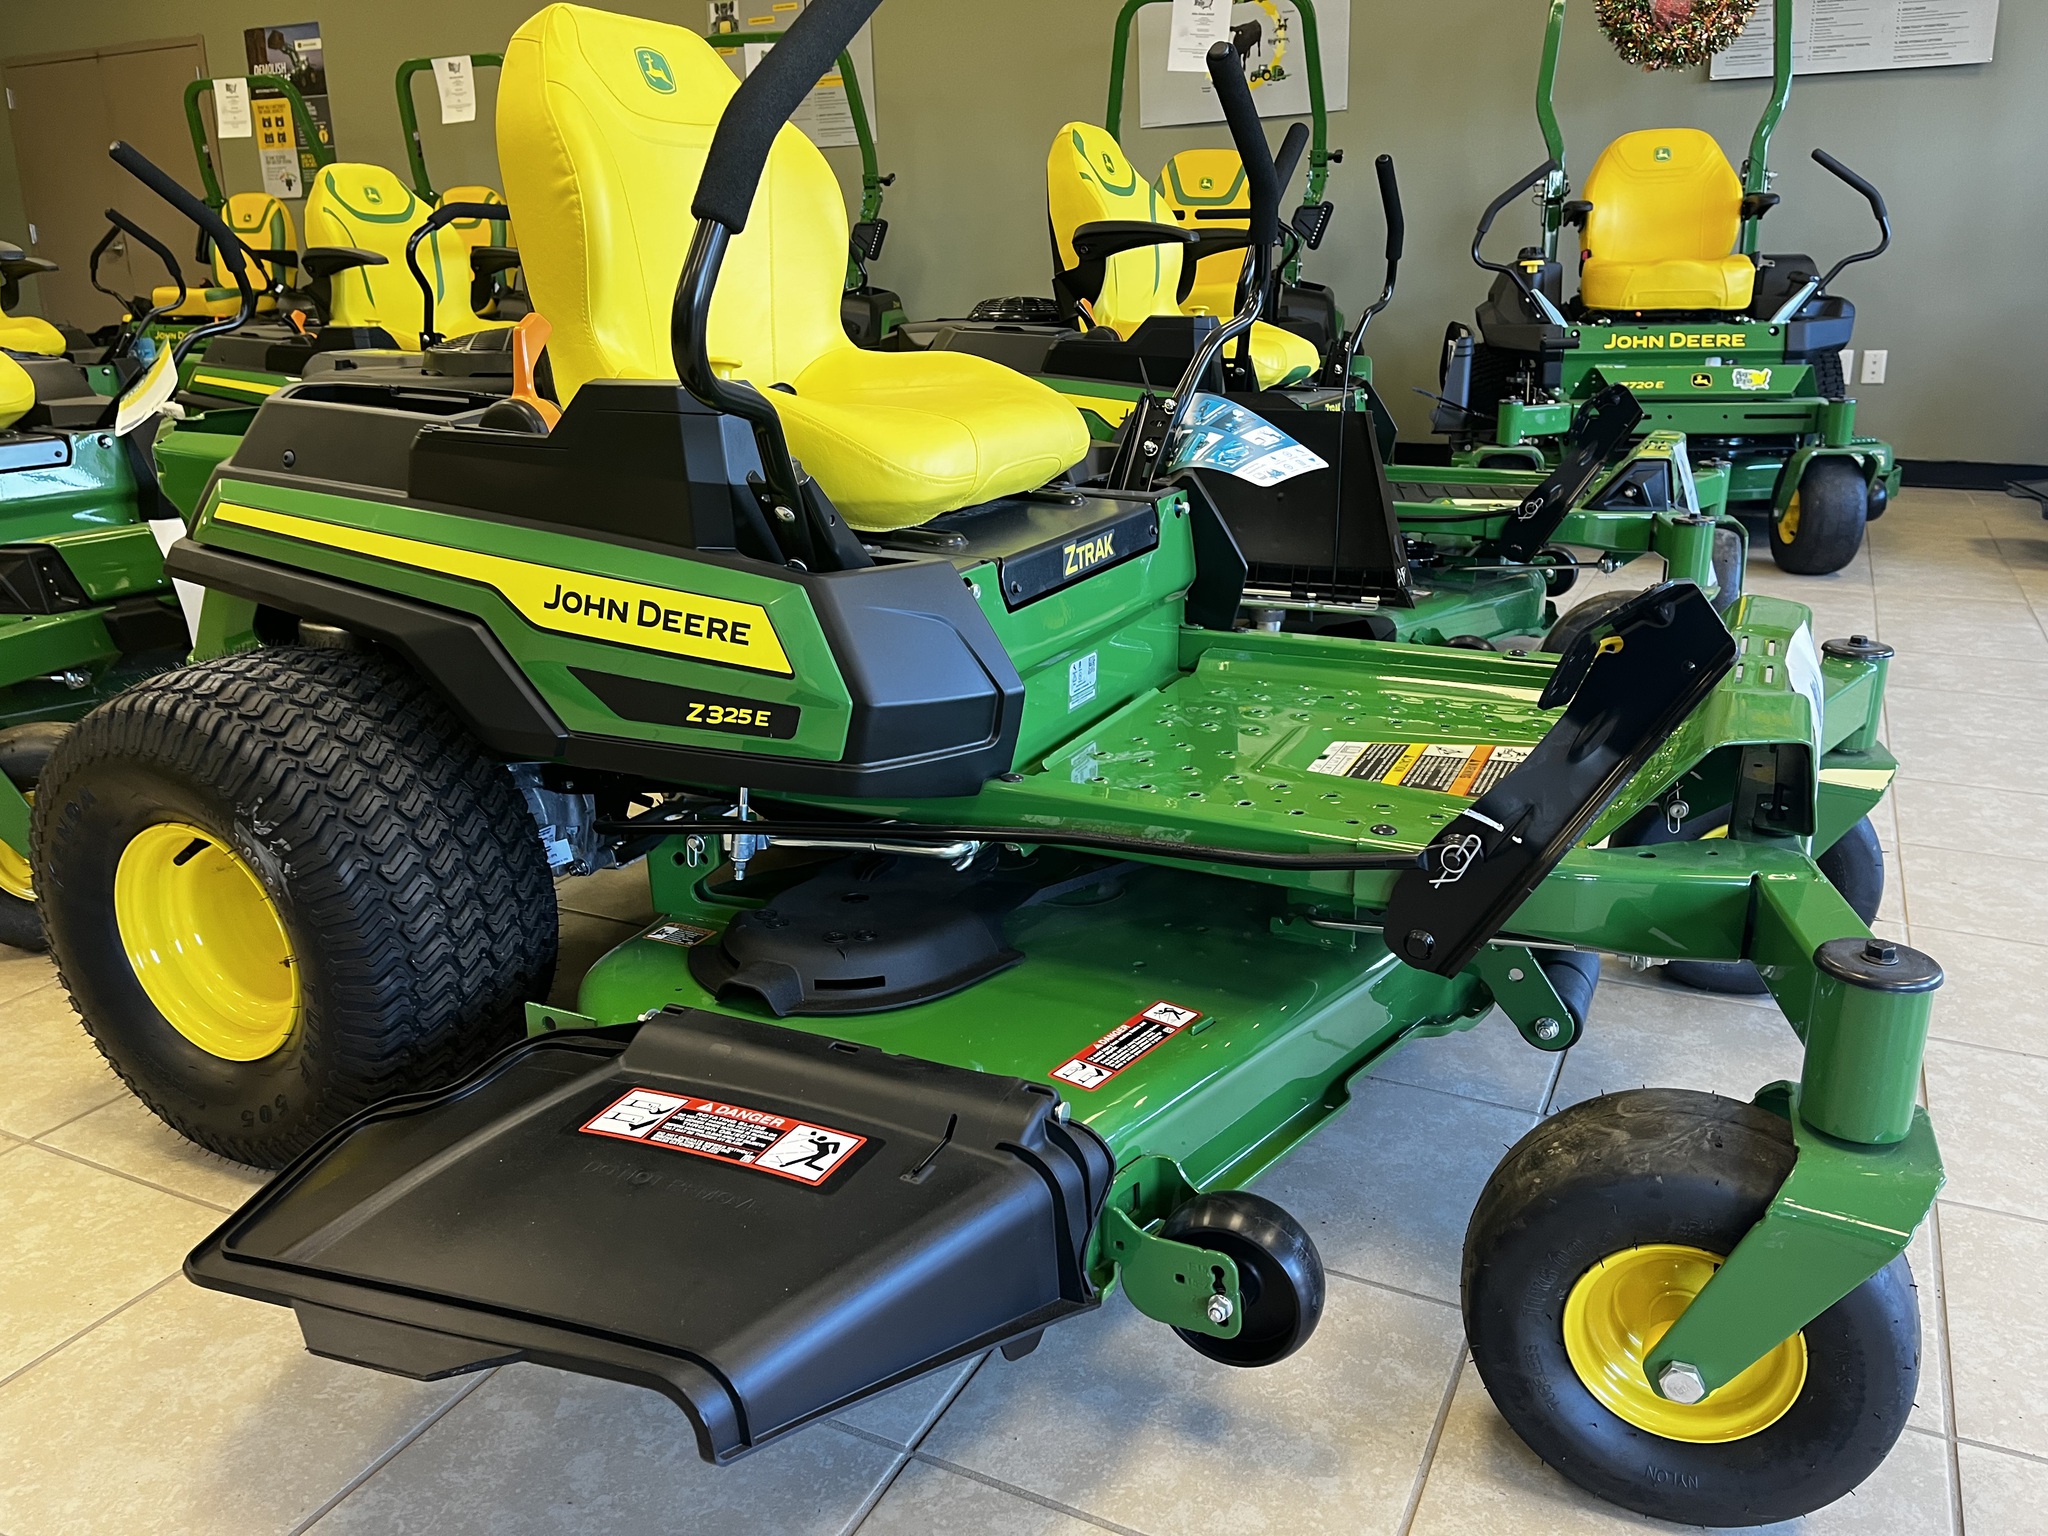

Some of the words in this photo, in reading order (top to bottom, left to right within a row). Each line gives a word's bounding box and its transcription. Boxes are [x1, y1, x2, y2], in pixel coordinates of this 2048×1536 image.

[253, 62, 287, 75] DEMOLISH
[1603, 333, 1665, 349] JOHN
[1669, 332, 1746, 349] DEERE
[543, 584, 629, 624] JOHN
[636, 599, 752, 646] DEERE
[1098, 1024, 1131, 1045] DANGER
[694, 1112, 738, 1124] ROTATING
[736, 1120, 768, 1130] BLADE
[715, 1105, 786, 1128] DANGER
[680, 1121, 718, 1132] THROWN
[716, 1129, 758, 1141] OBJECTS
[1644, 1465, 1699, 1490] NYLON
